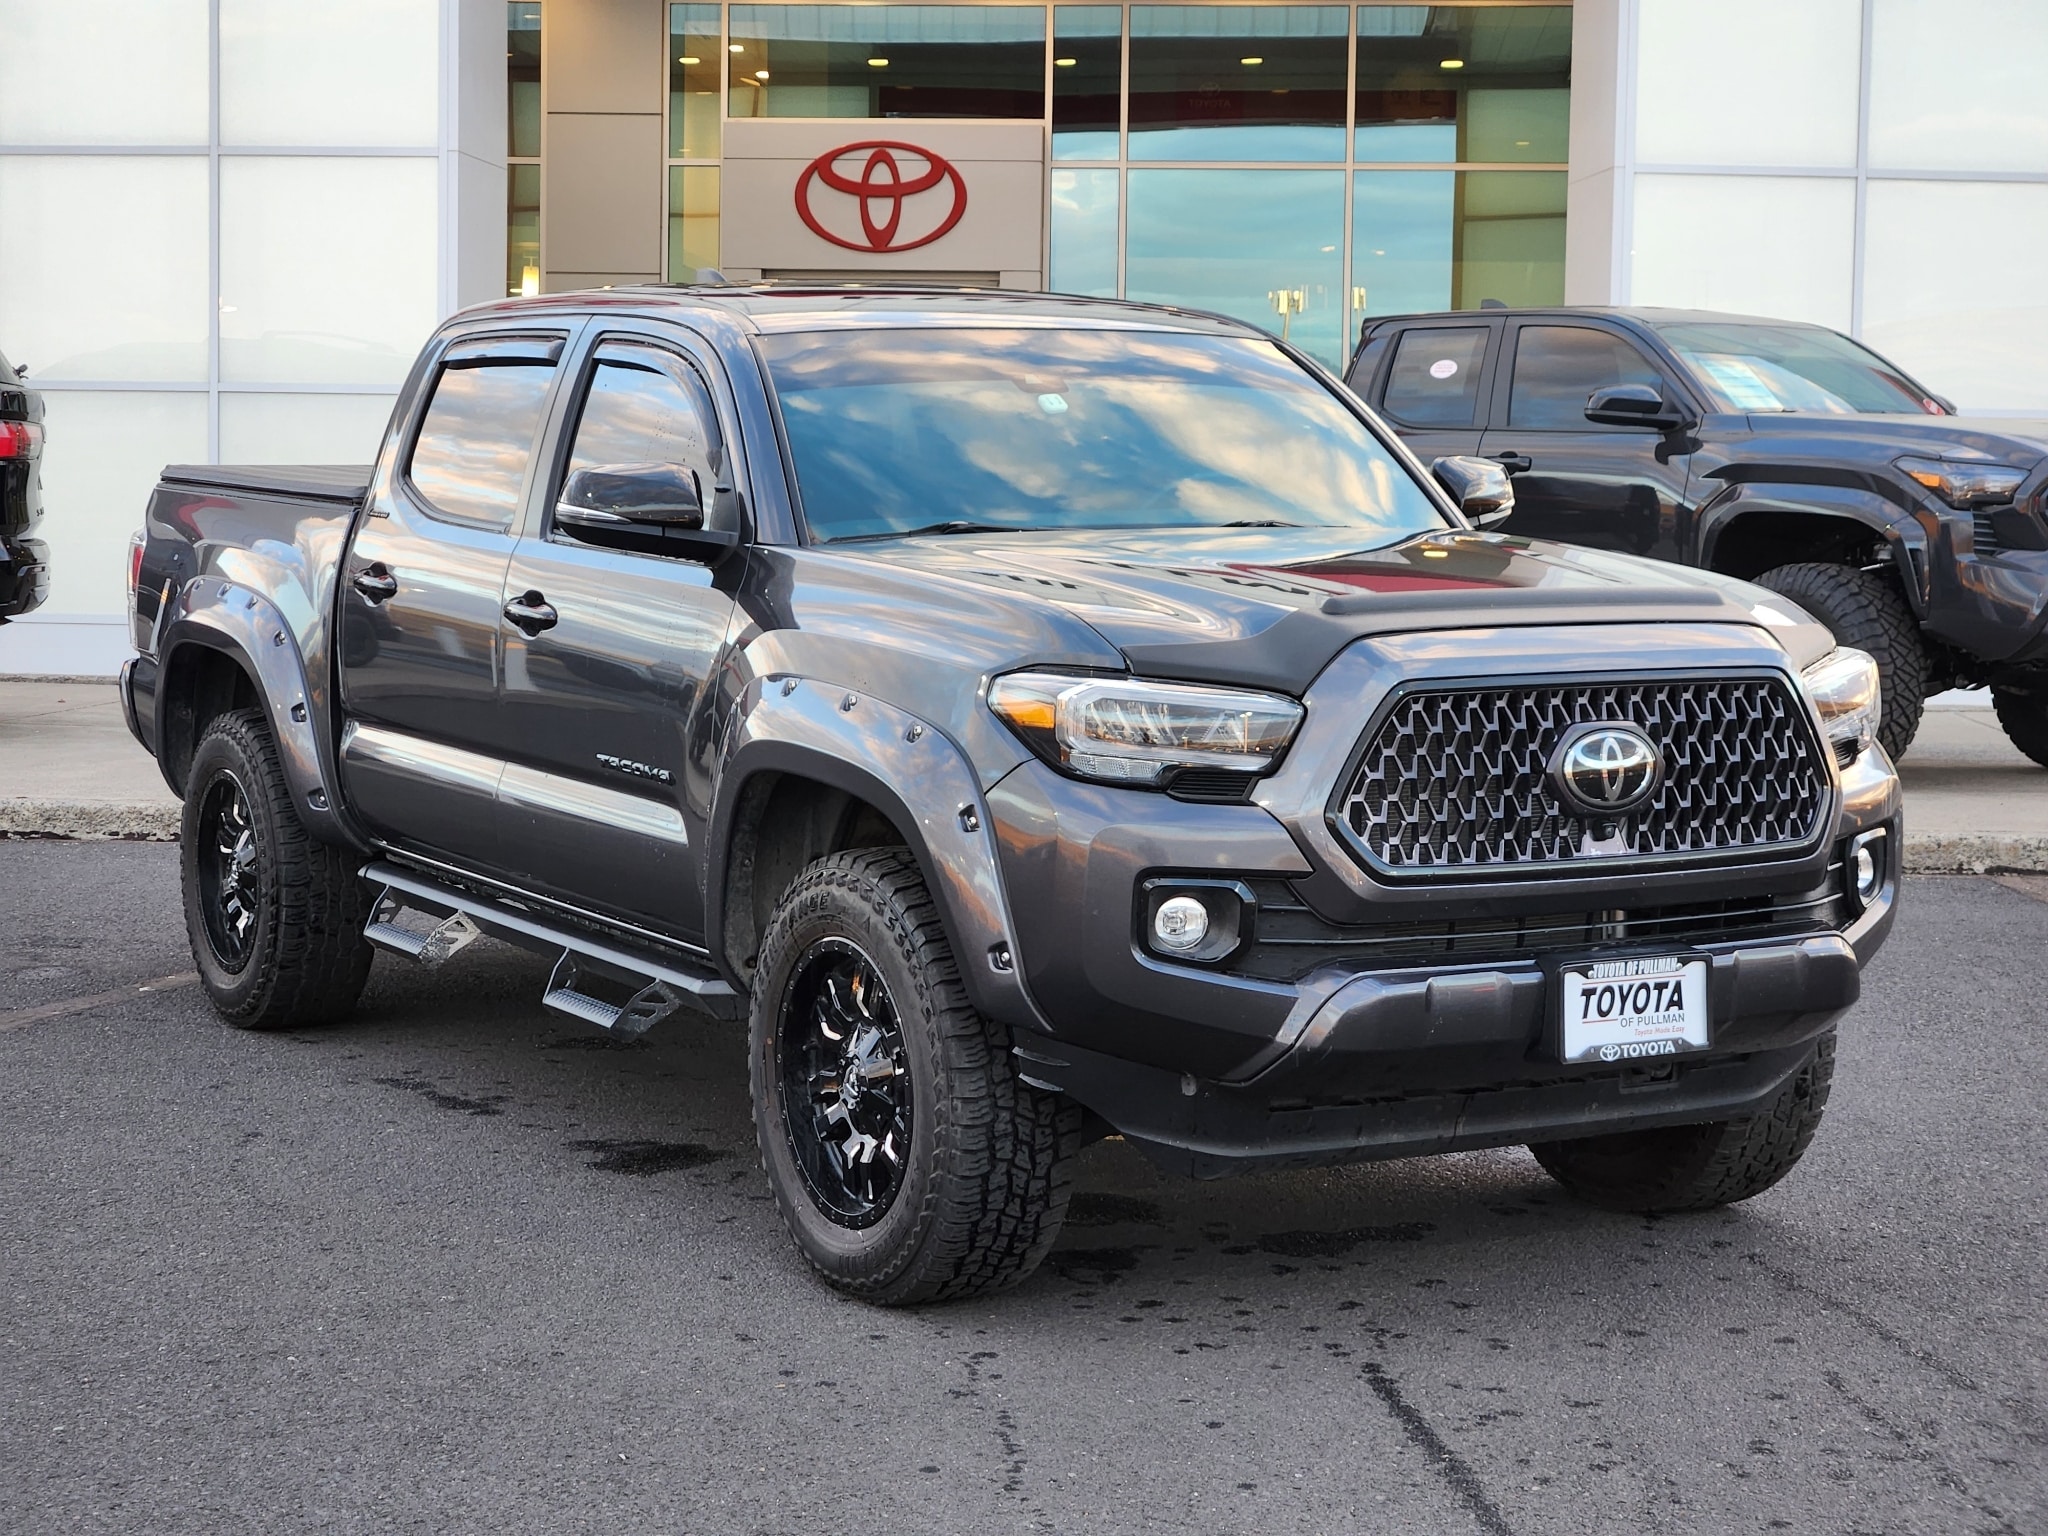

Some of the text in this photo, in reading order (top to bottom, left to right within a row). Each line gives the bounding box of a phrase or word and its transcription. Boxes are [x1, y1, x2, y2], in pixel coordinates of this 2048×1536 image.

[596, 753, 673, 783] TACOMA
[1593, 957, 1678, 978] TOYOTA OF PULLMAN
[1580, 980, 1684, 1019] TOYOTA
[1620, 1013, 1685, 1028] OF PULLMAN
[1621, 1041, 1675, 1058] TOYOTA
